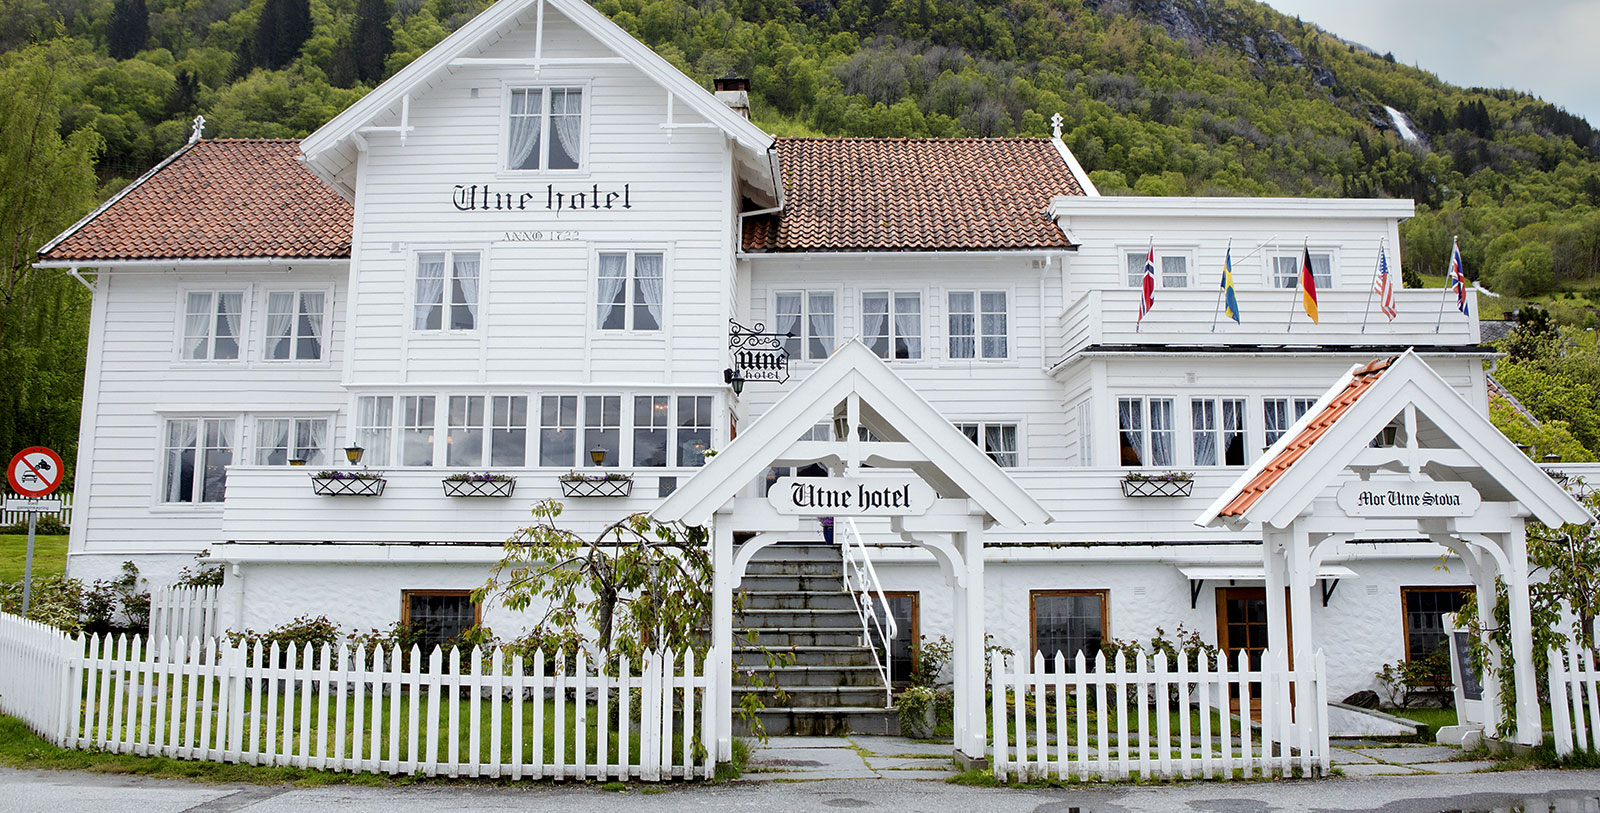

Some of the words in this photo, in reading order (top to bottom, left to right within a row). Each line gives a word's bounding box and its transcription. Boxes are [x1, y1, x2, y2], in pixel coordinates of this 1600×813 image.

[453, 184, 533, 211] Utne
[545, 183, 632, 218] hotel
[502, 231, 543, 241] ANNO
[550, 231, 580, 241] 1722
[746, 370, 778, 379] hotel
[792, 482, 852, 507] Utne
[858, 483, 910, 512] hotel
[1358, 491, 1386, 506] Mor
[1387, 491, 1420, 506] Utne
[1422, 491, 1461, 506] Stova
